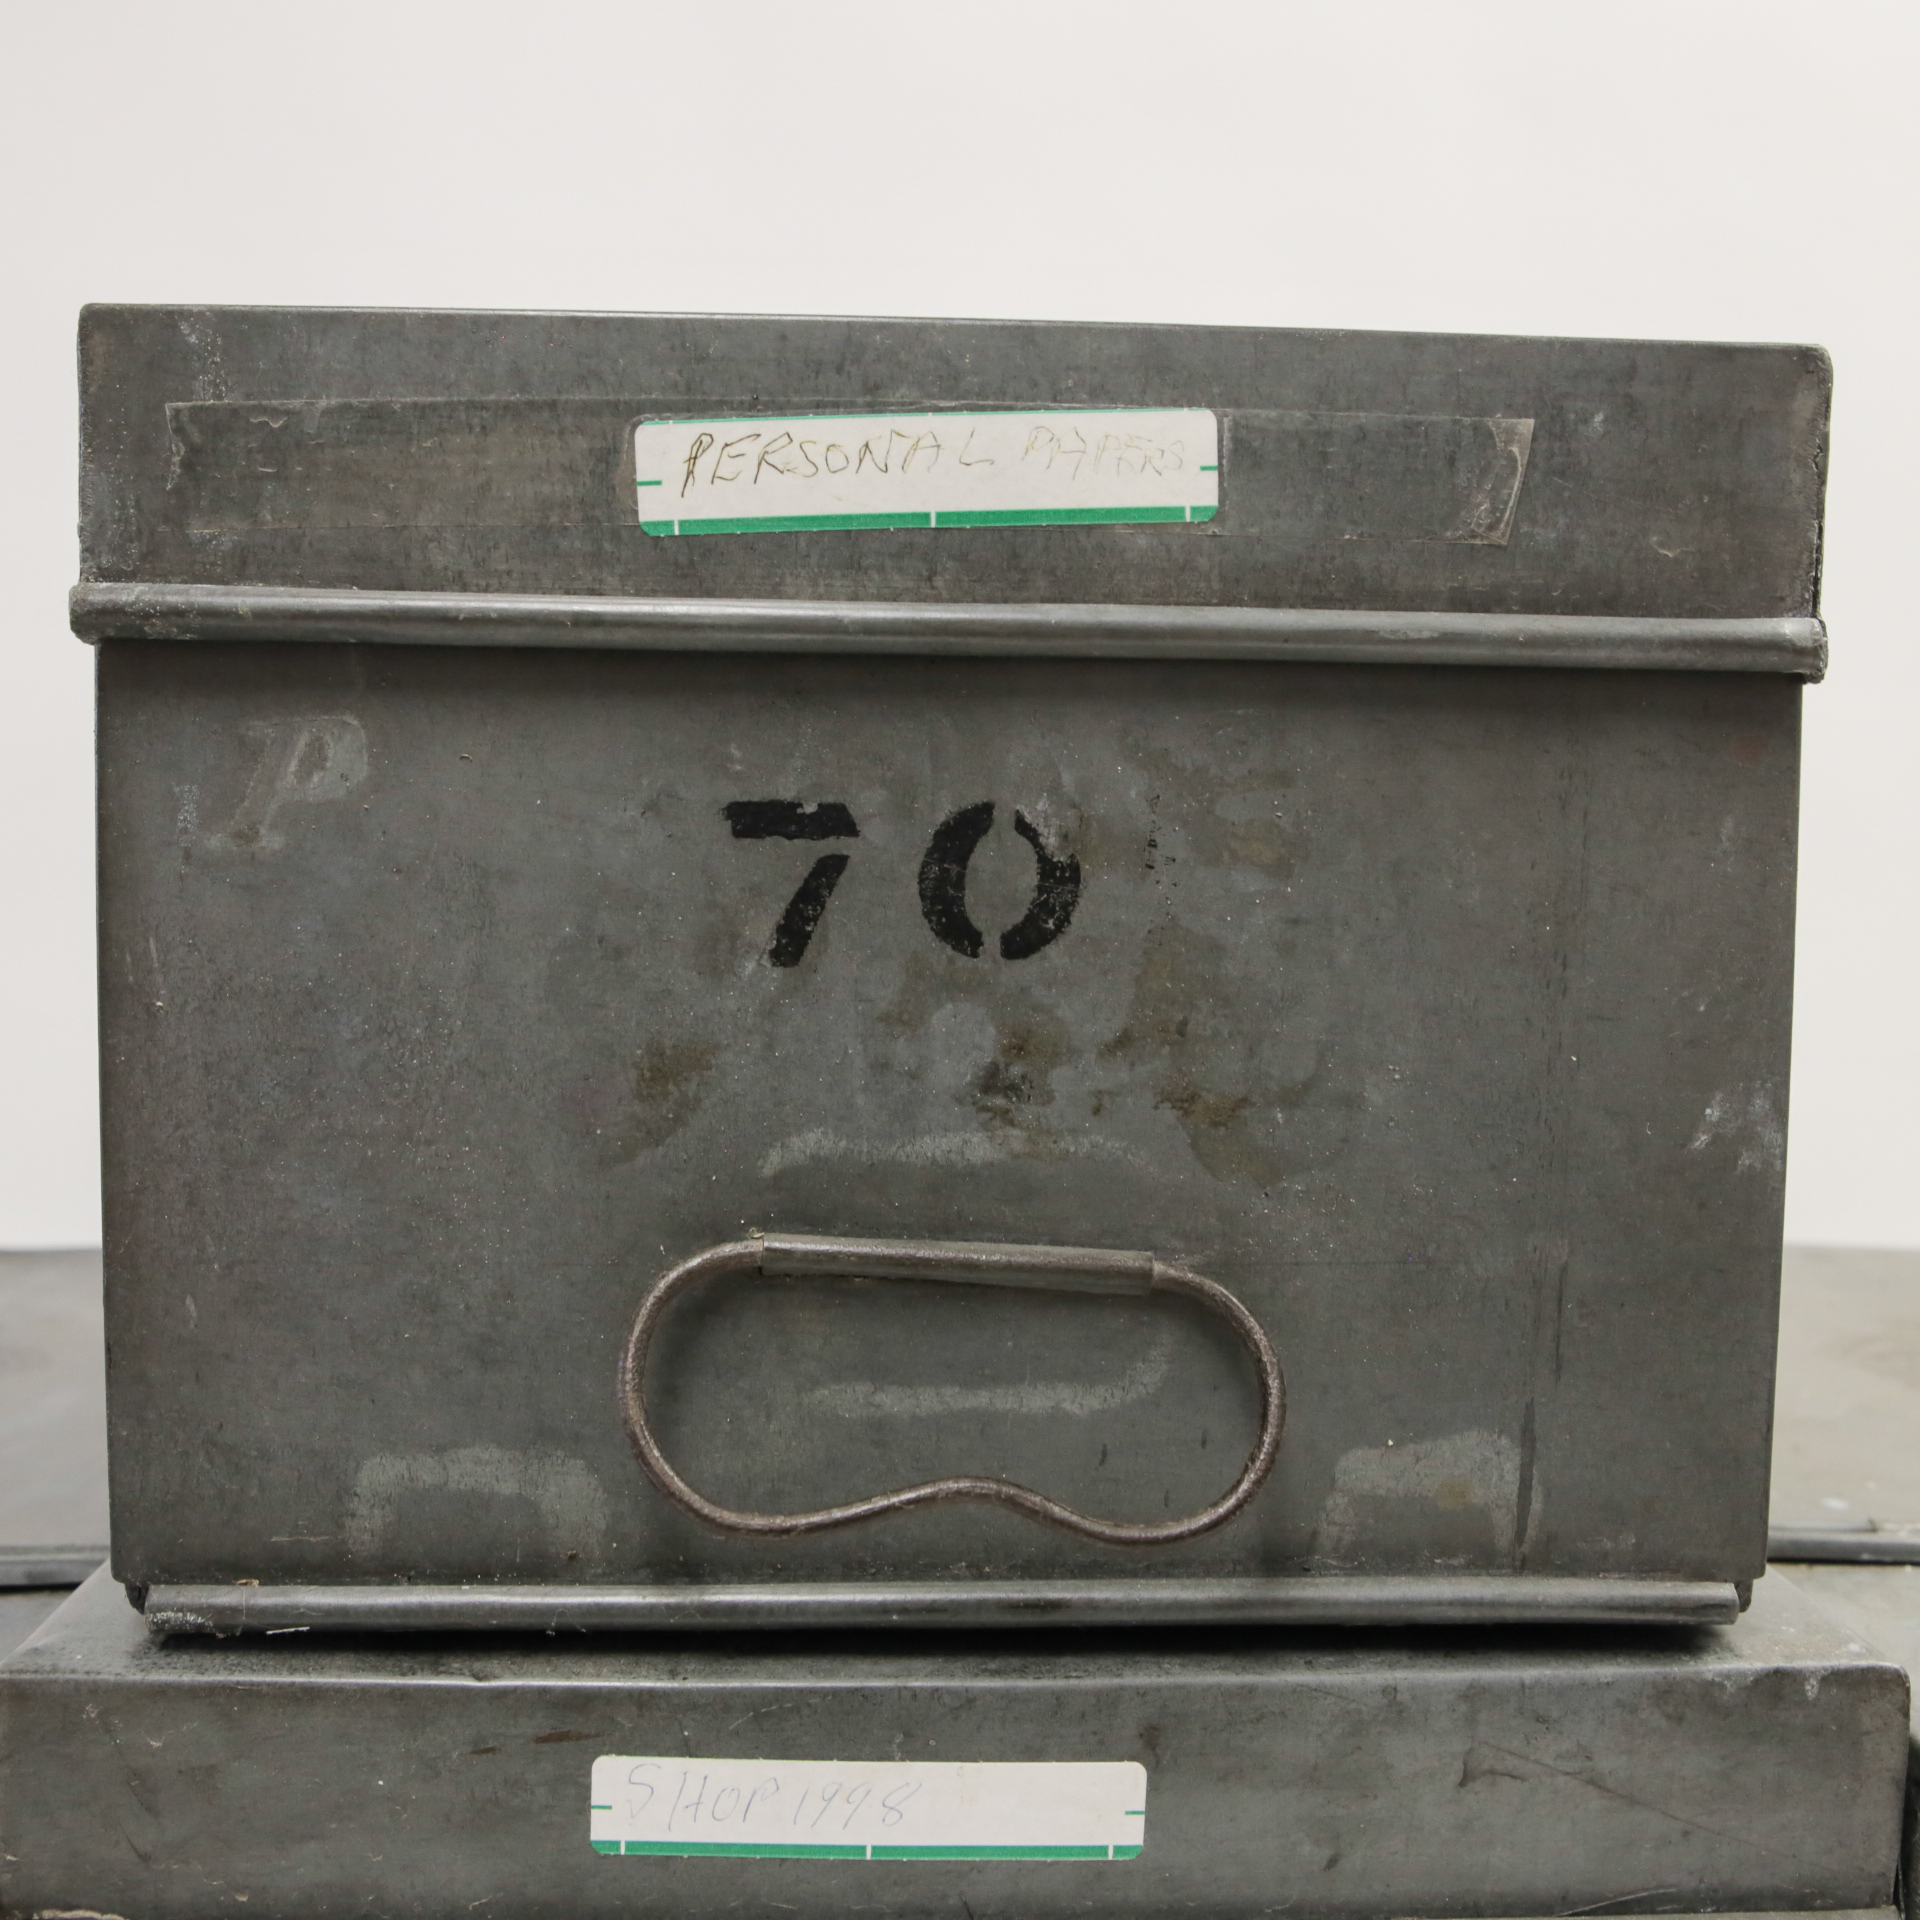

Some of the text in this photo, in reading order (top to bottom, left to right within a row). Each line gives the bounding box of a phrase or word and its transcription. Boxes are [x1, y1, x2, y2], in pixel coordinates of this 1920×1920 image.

[681, 426, 996, 499] PERSONAL
[718, 800, 1082, 968] 70
[625, 1762, 923, 1832] SHOP 1998
